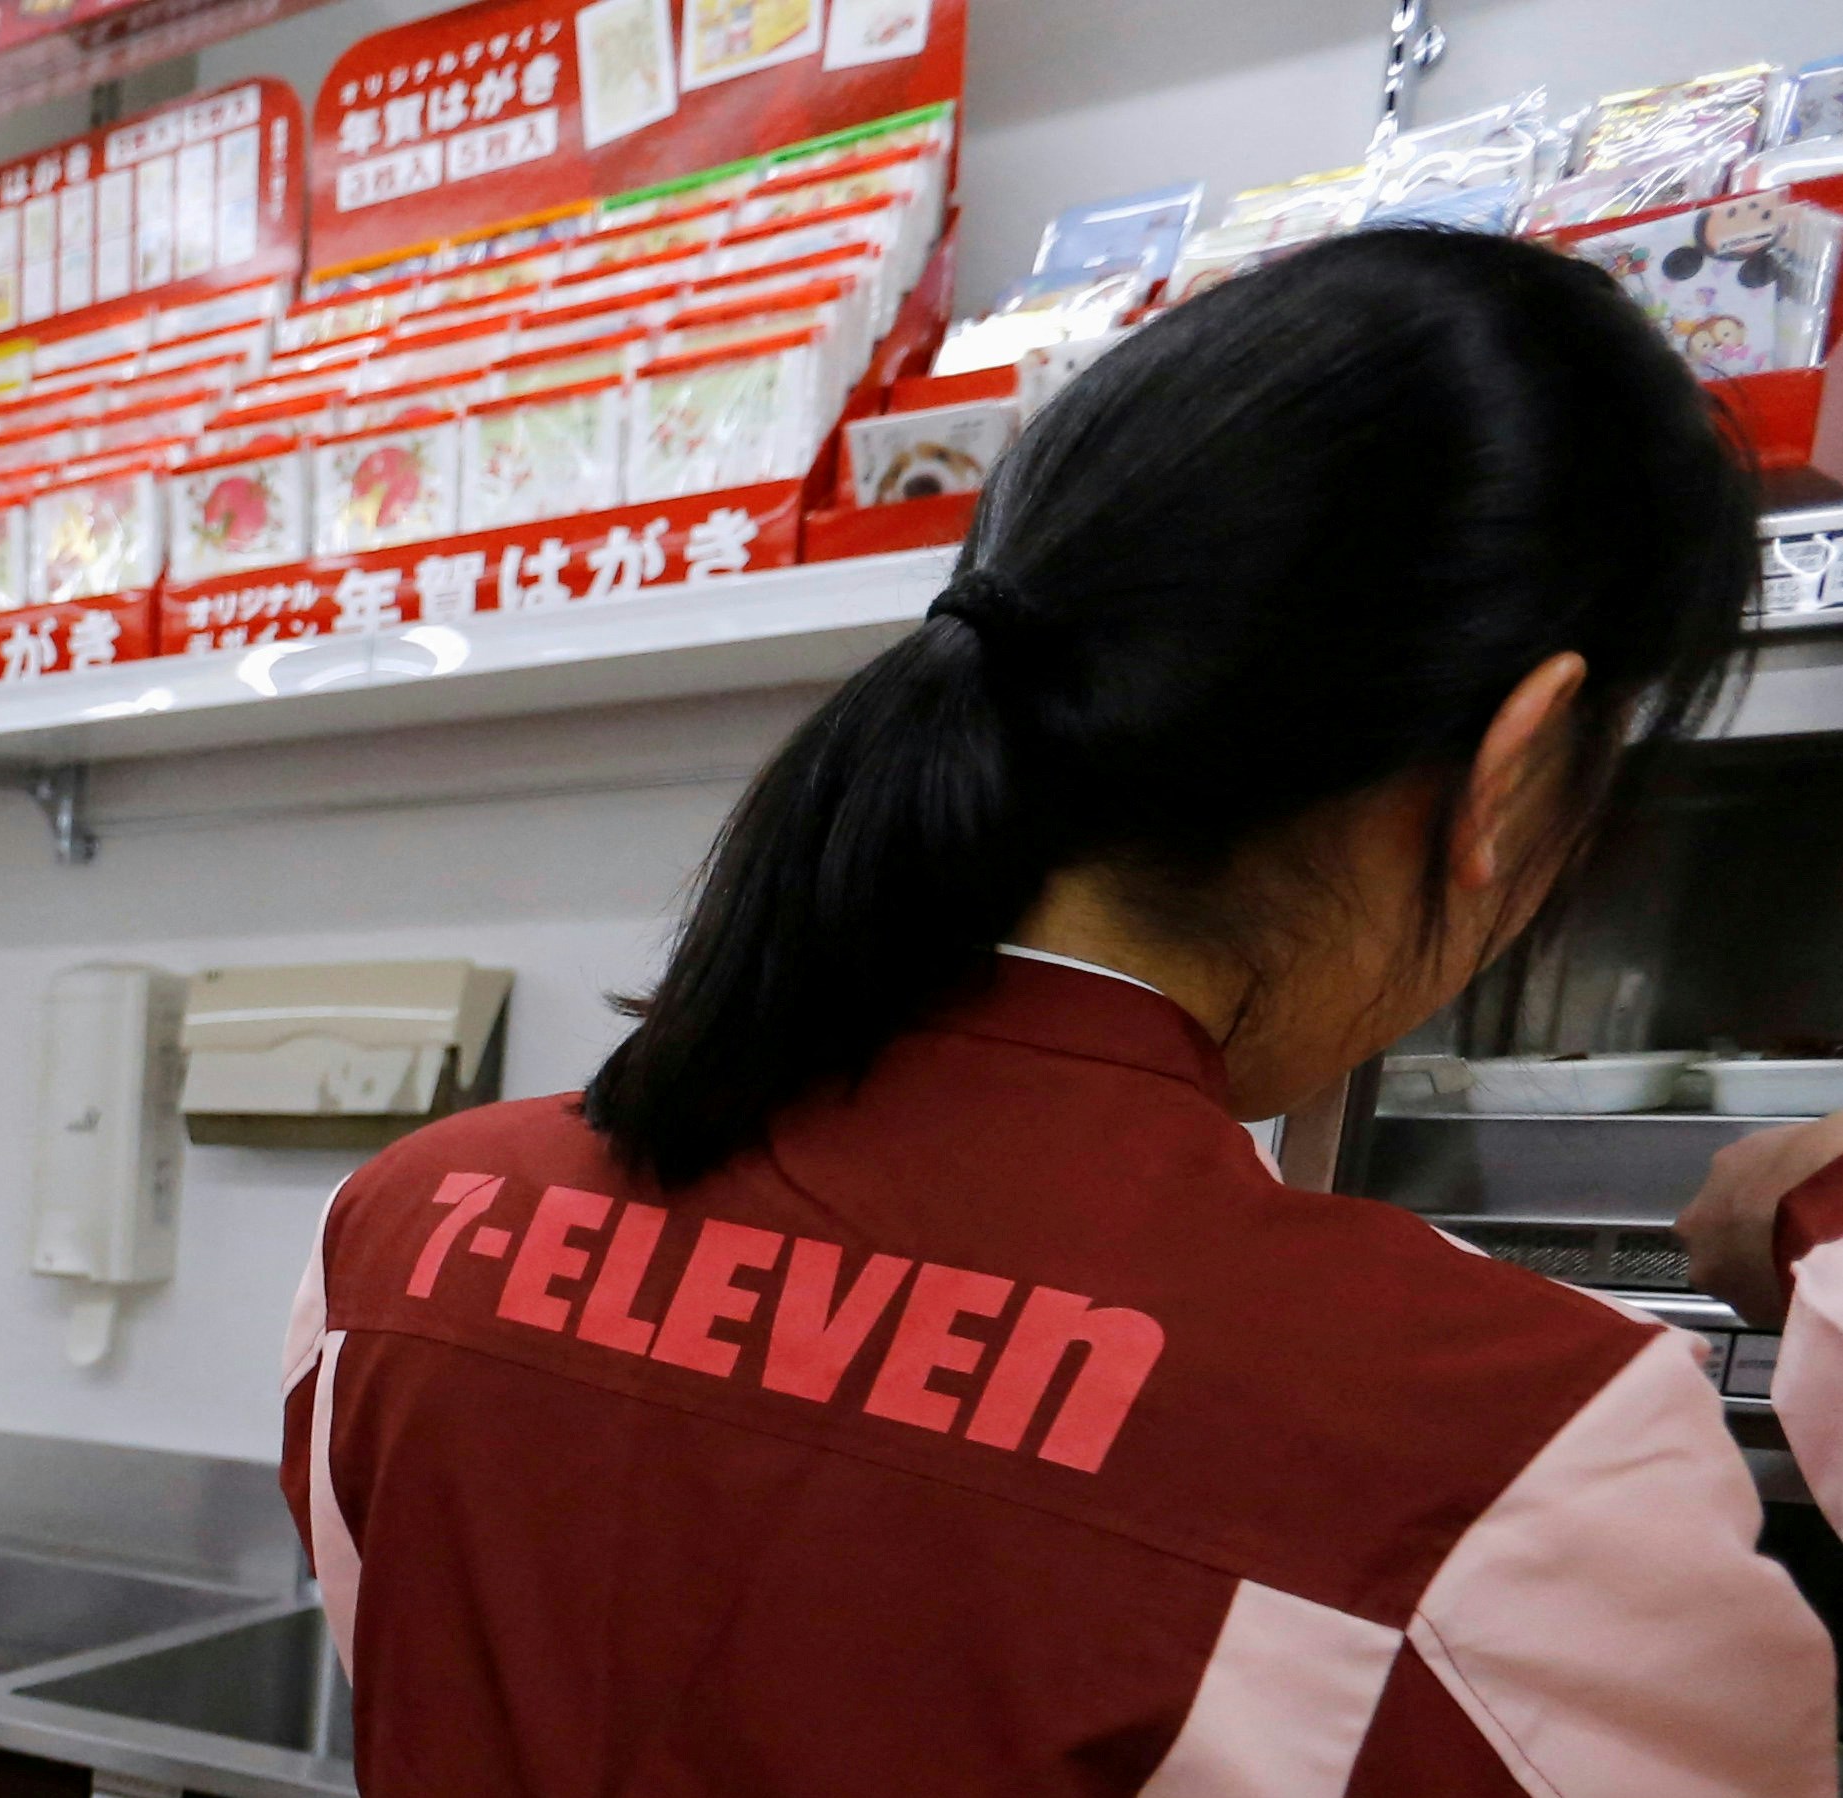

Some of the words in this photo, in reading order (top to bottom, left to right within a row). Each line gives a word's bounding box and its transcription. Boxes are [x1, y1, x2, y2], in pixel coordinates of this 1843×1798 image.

[336, 52, 562, 156] 年賀はがき
[329, 506, 759, 633] 年賀はがき
